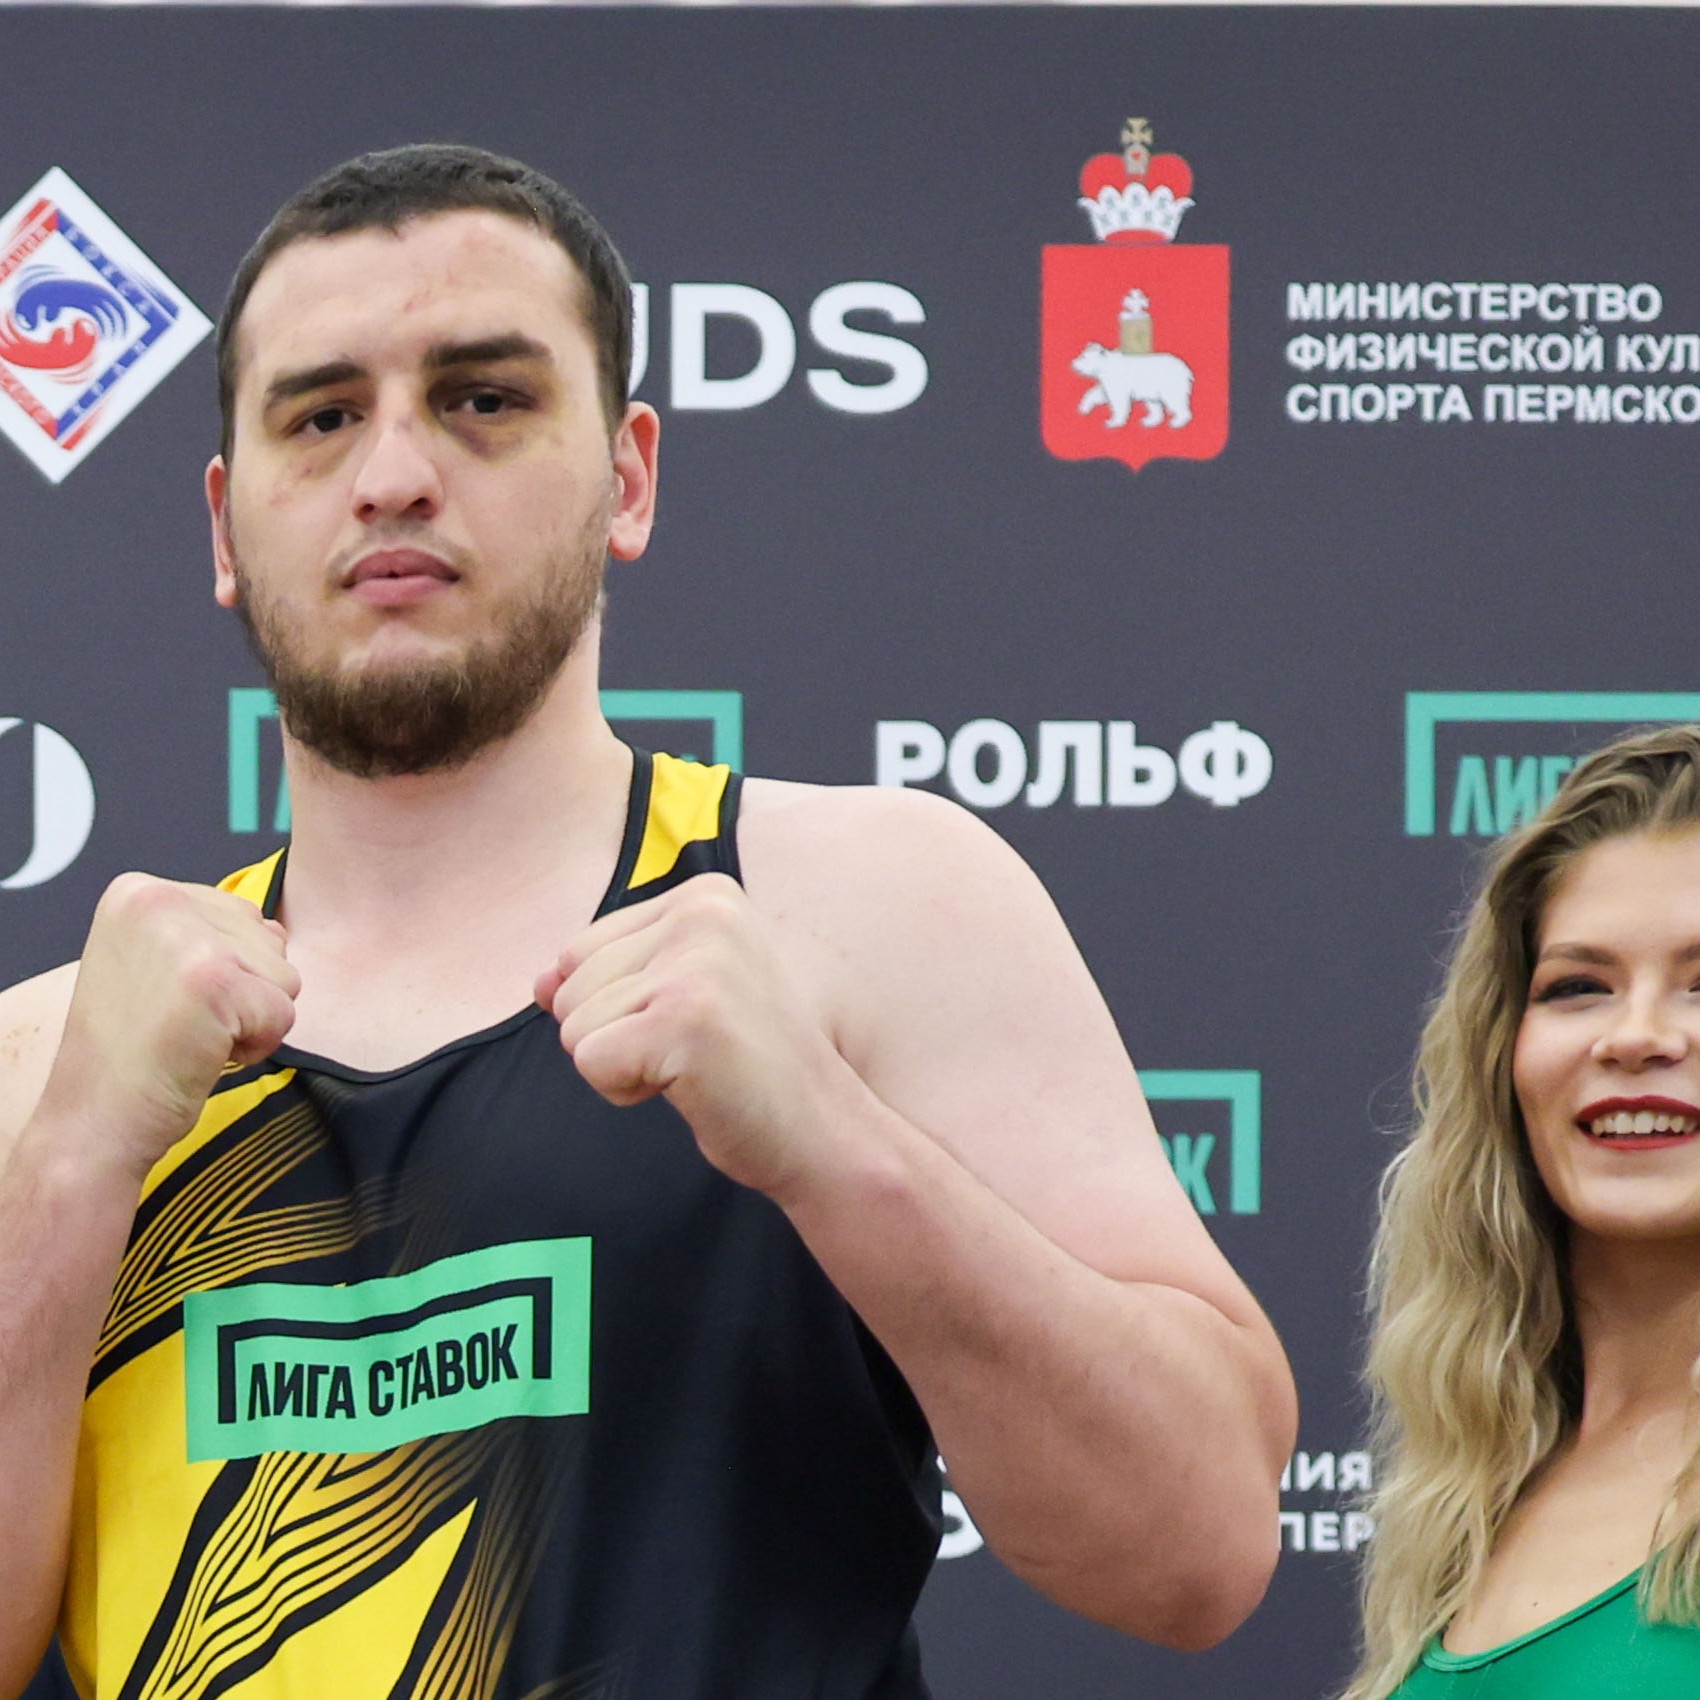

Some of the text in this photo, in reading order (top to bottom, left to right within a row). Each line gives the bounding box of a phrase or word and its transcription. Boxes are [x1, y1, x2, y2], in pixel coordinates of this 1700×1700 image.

[1286, 281, 1663, 323] МИНИСТЕРСТВО
[1286, 323, 1700, 373] ФИЗИЧЕСКОЙ КУЛ
[1286, 383, 1700, 424] СПОРТА ПЕРМСКО
[875, 718, 1274, 808] РОЛЬФ
[1450, 754, 1592, 836] ЛИГ
[247, 1323, 519, 1421] ЛИГА СТАВОК
